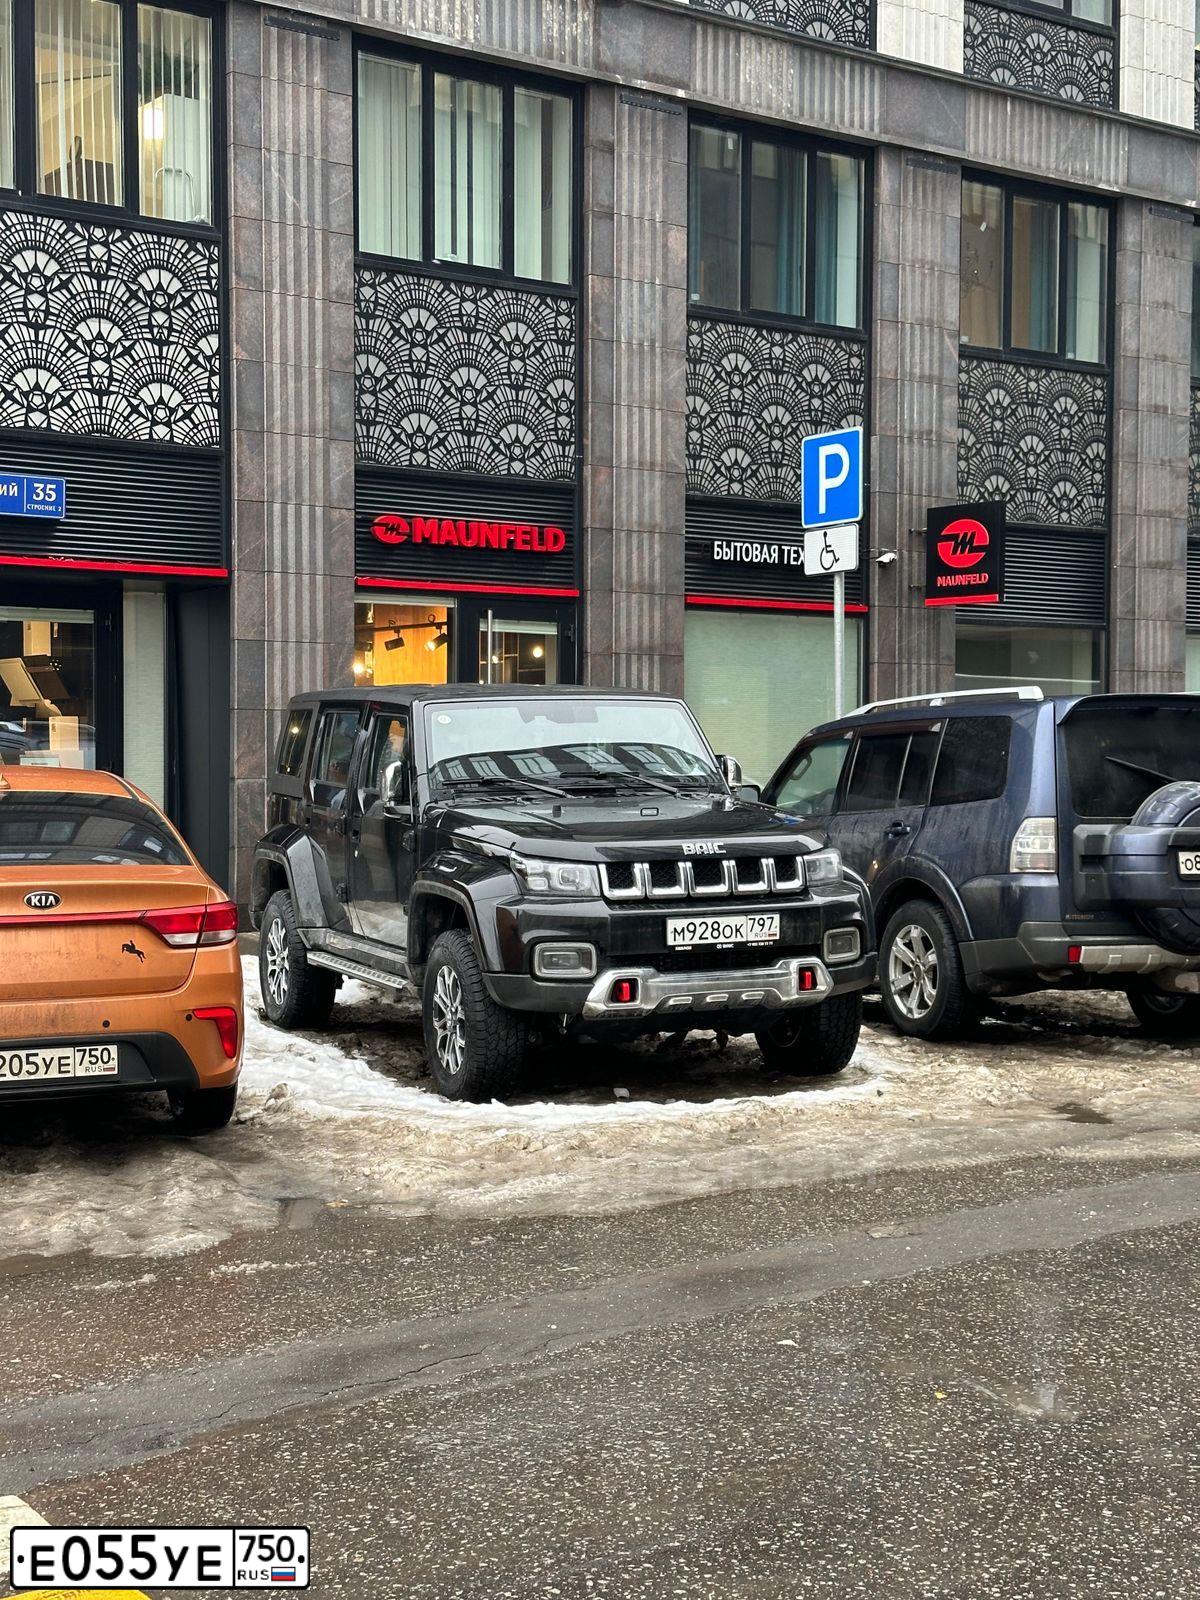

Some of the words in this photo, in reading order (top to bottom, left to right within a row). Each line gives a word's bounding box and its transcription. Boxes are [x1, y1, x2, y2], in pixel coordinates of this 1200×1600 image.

[818, 443, 850, 515] P
[32, 482, 57, 502] 35
[27, 503, 56, 511] СТРОЕНИЕ
[412, 517, 566, 552] MAUNFELD
[713, 540, 779, 564] БЫТОВАЯ
[937, 573, 989, 587] MAUNFELD
[682, 842, 727, 855] BAIC
[30, 895, 56, 907] KIA
[673, 921, 745, 942] М928ОК
[749, 916, 775, 933] 797
[76, 1047, 112, 1067] 750
[85, 1065, 103, 1073] RUS
